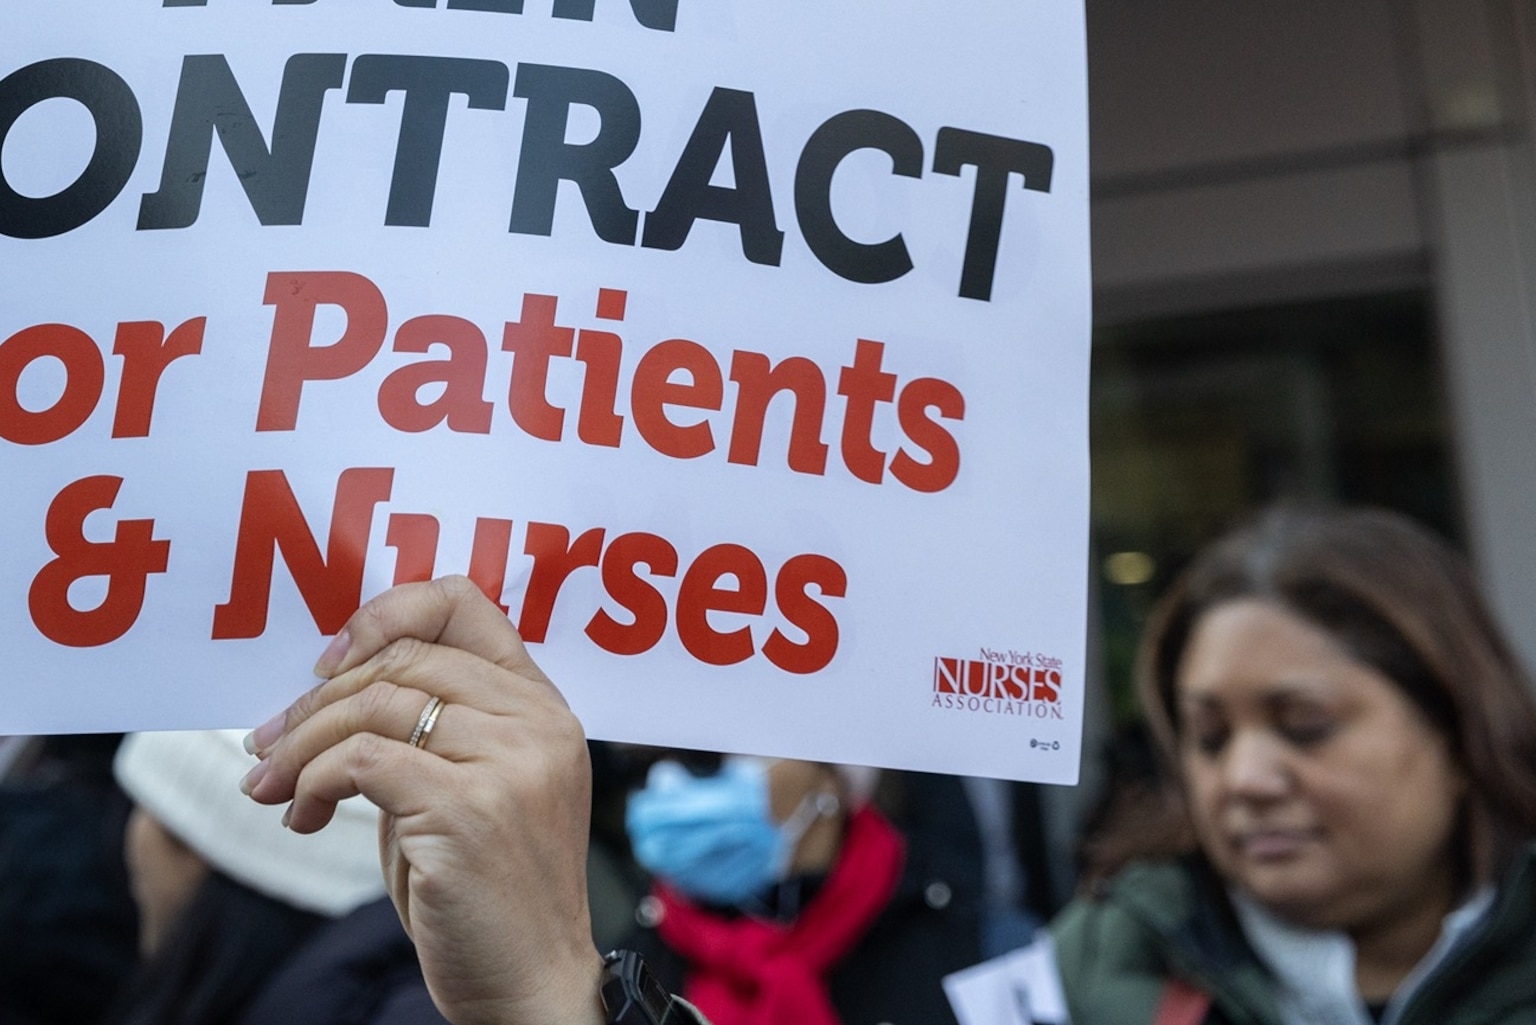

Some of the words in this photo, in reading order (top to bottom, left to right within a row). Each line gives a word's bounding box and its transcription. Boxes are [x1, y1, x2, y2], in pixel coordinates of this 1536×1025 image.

[257, 271, 966, 494] Patients
[28, 475, 171, 647] &
[211, 466, 848, 675] Nurses
[932, 656, 1062, 705] NURSES
[980, 647, 1008, 663] New
[1008, 649, 1034, 667] York
[1035, 652, 1063, 669] State
[931, 693, 1064, 720] ASSOCIATION
